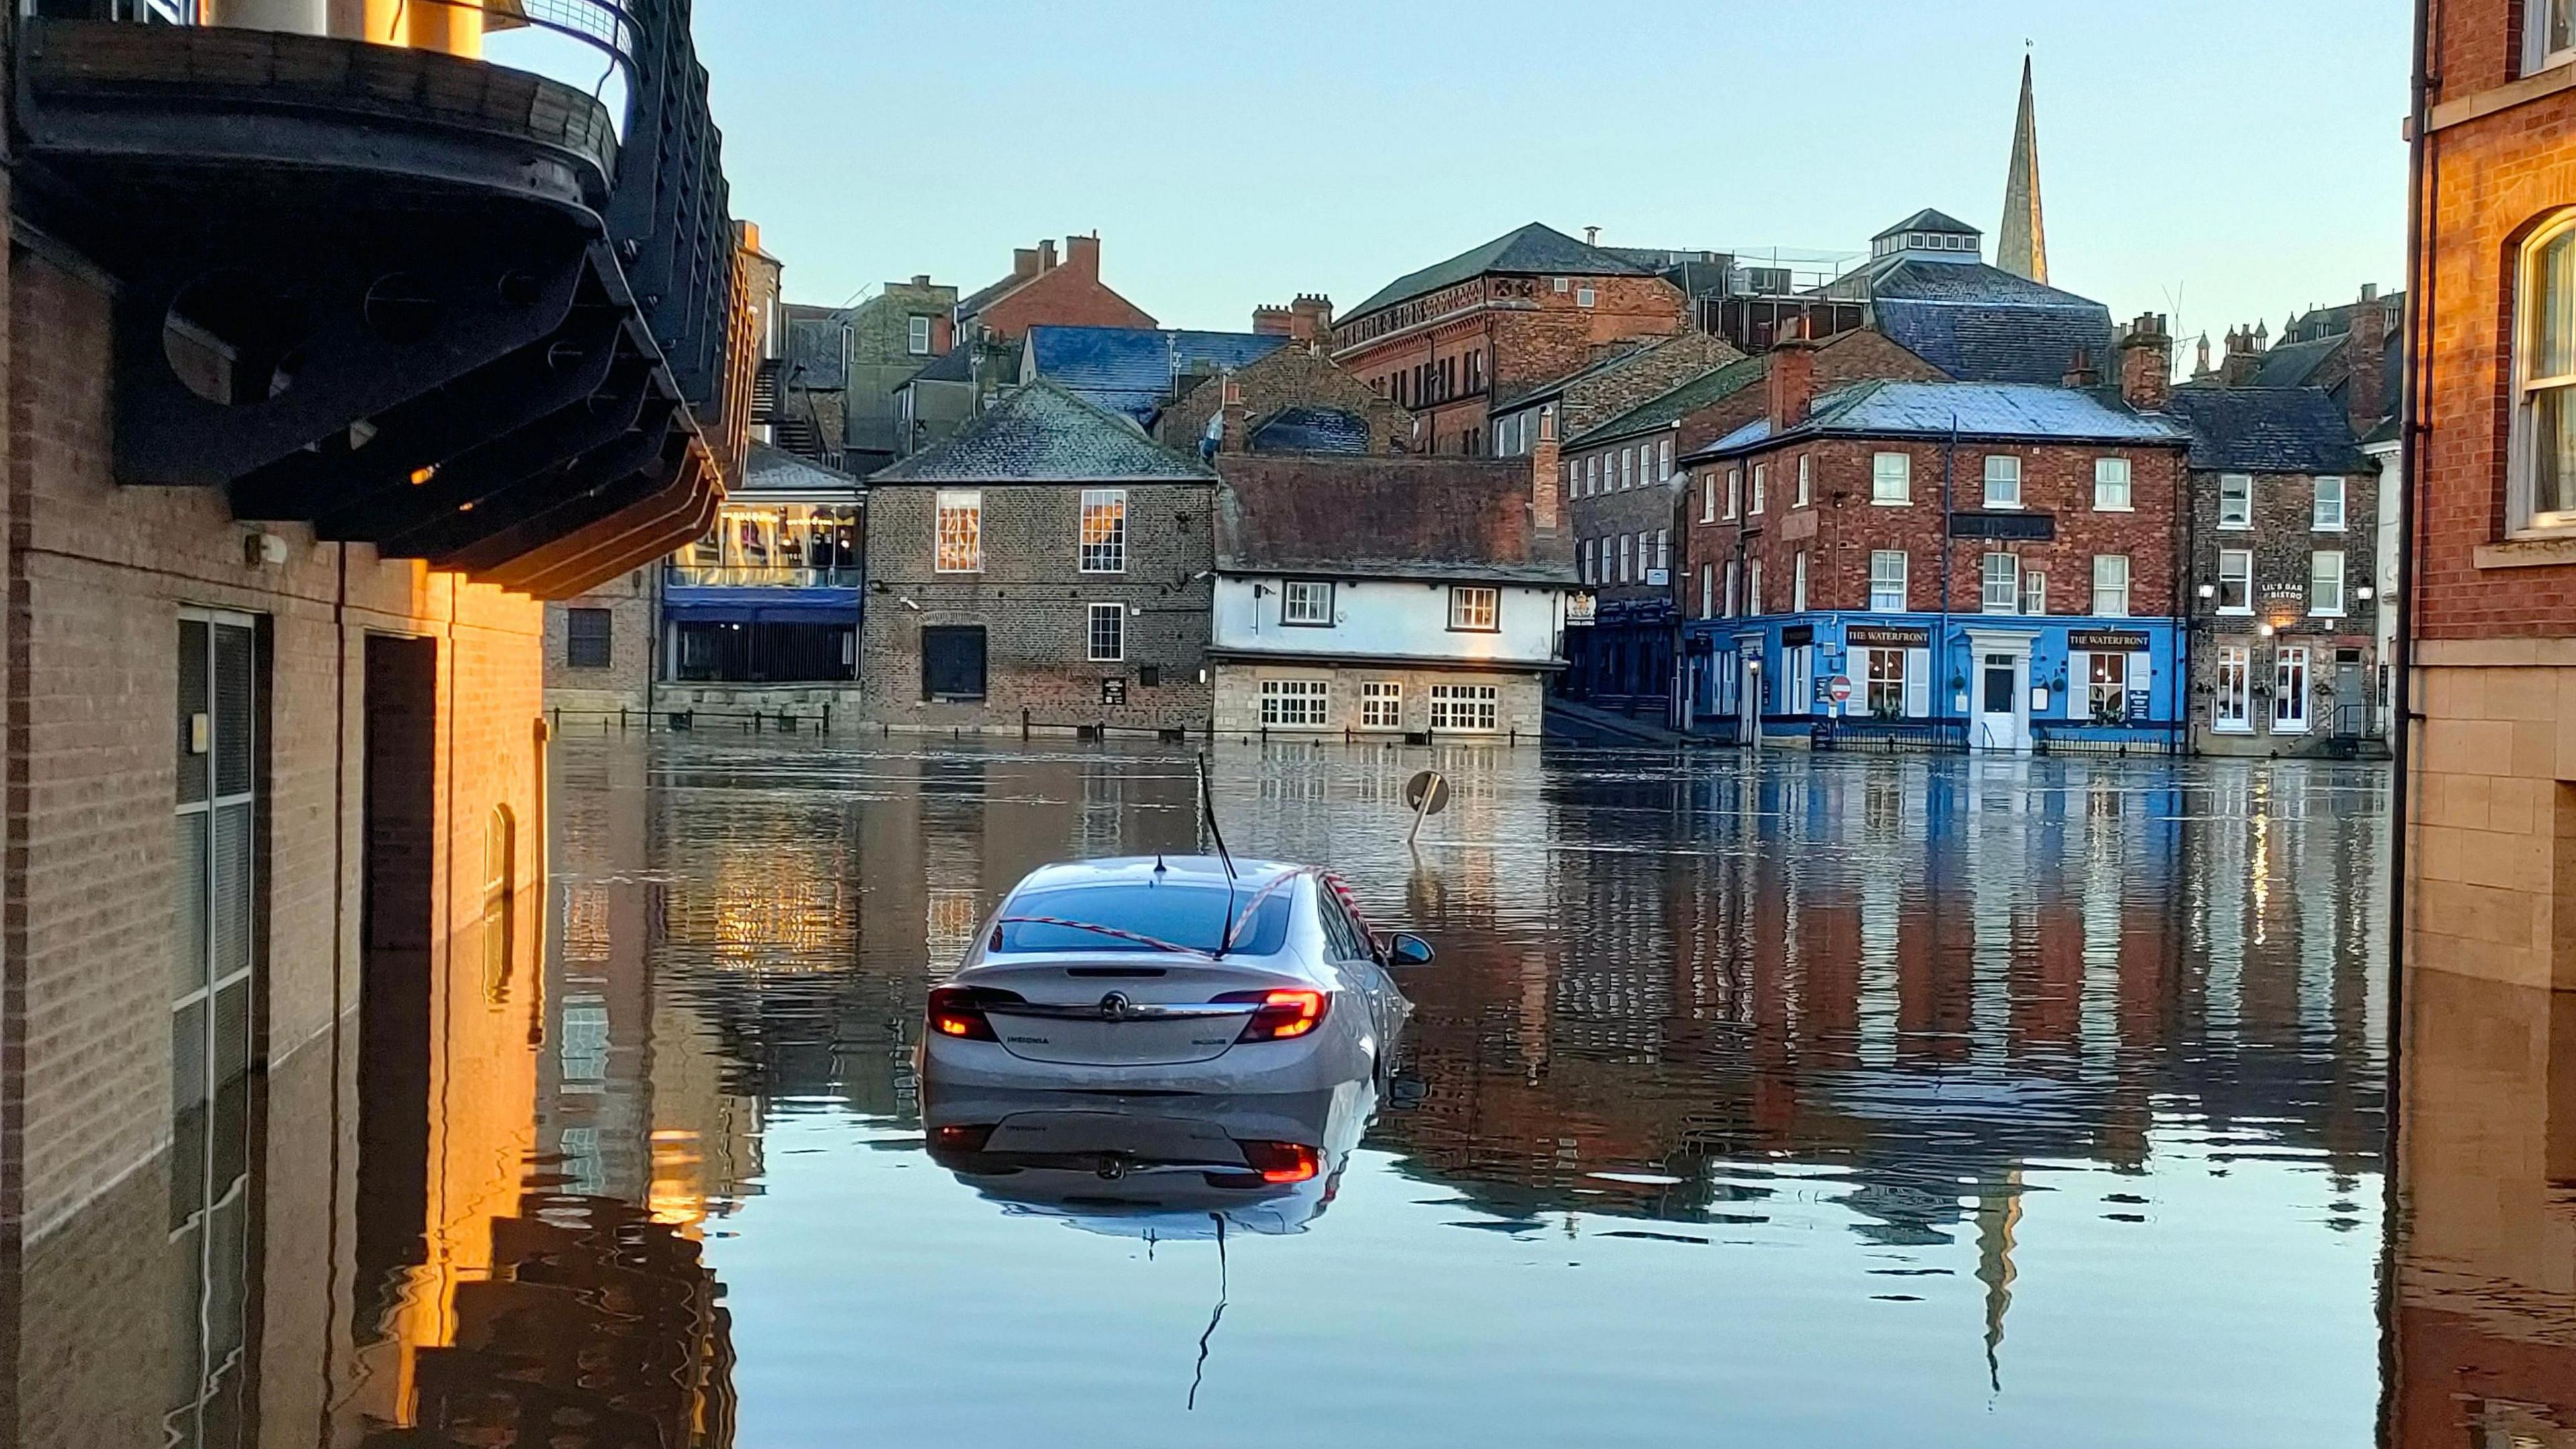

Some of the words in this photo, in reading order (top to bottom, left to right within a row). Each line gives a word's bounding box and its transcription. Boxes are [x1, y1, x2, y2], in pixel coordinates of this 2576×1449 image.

[2261, 583, 2282, 591] LIL'S
[2285, 583, 2303, 592] BAR
[2271, 592, 2302, 600] BISTRO
[1848, 631, 1866, 640] THE
[1868, 632, 1929, 641] WATERFRONT
[2070, 636, 2088, 644] THE
[2089, 636, 2149, 645] WATERFRONT
